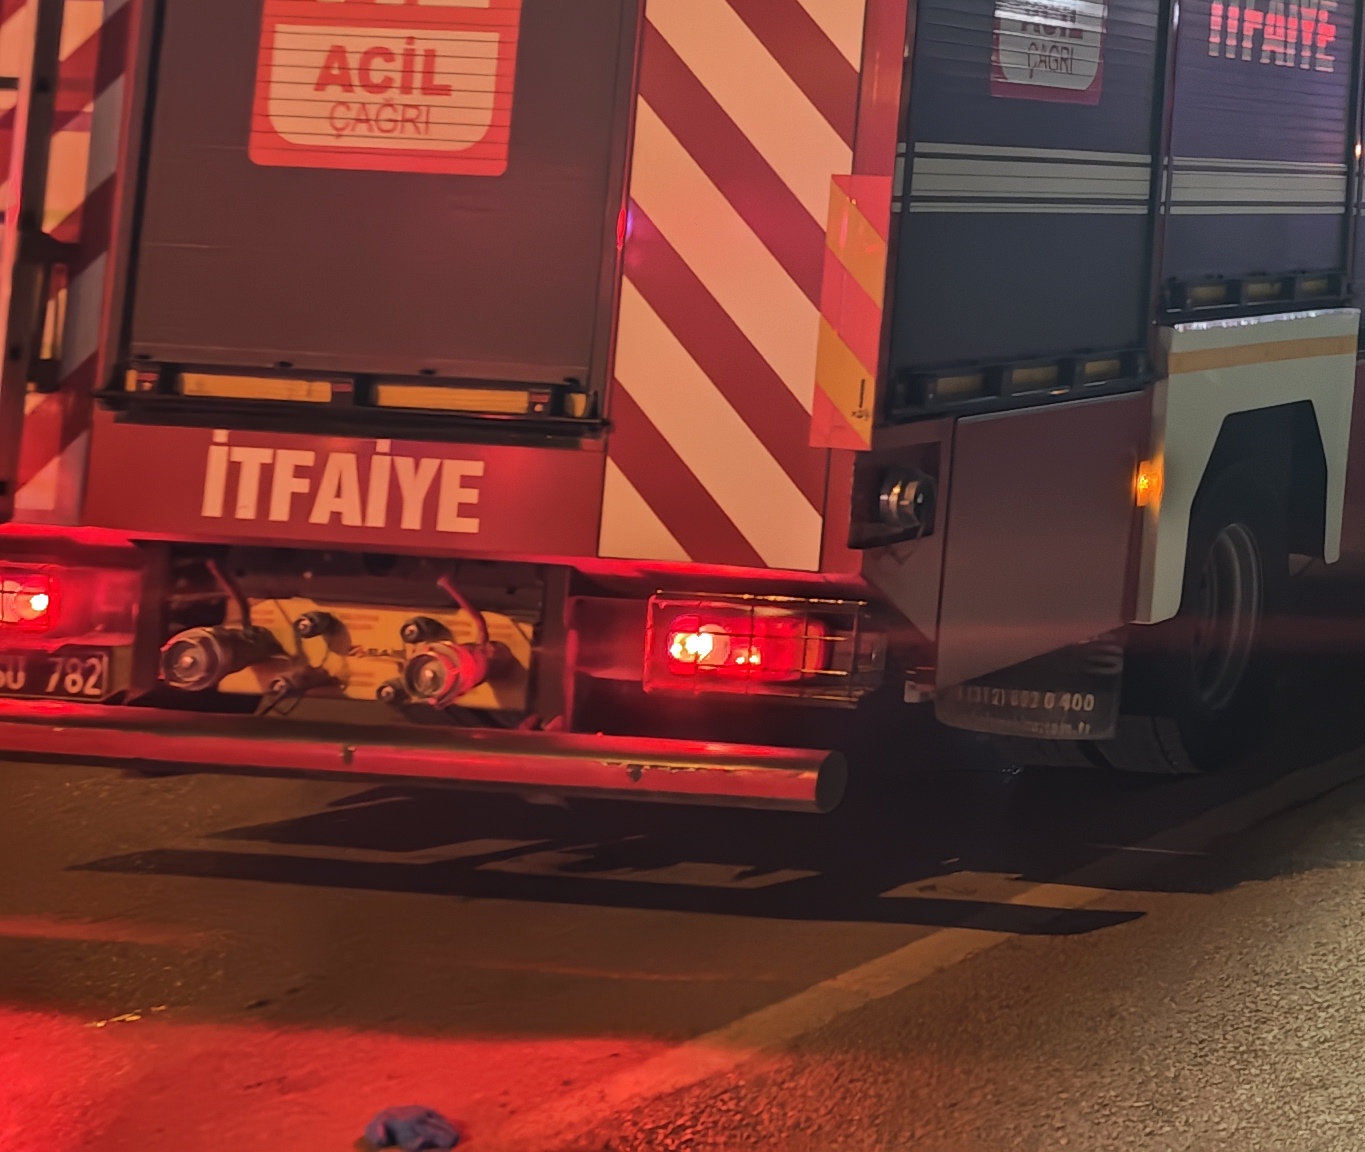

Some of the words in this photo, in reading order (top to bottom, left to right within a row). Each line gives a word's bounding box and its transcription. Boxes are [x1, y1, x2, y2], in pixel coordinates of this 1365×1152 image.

[313, 36, 452, 96] ACİL
[328, 97, 431, 139] ÇAĞRI
[201, 428, 485, 533] İTFAİYE
[45, 657, 102, 696] 782
